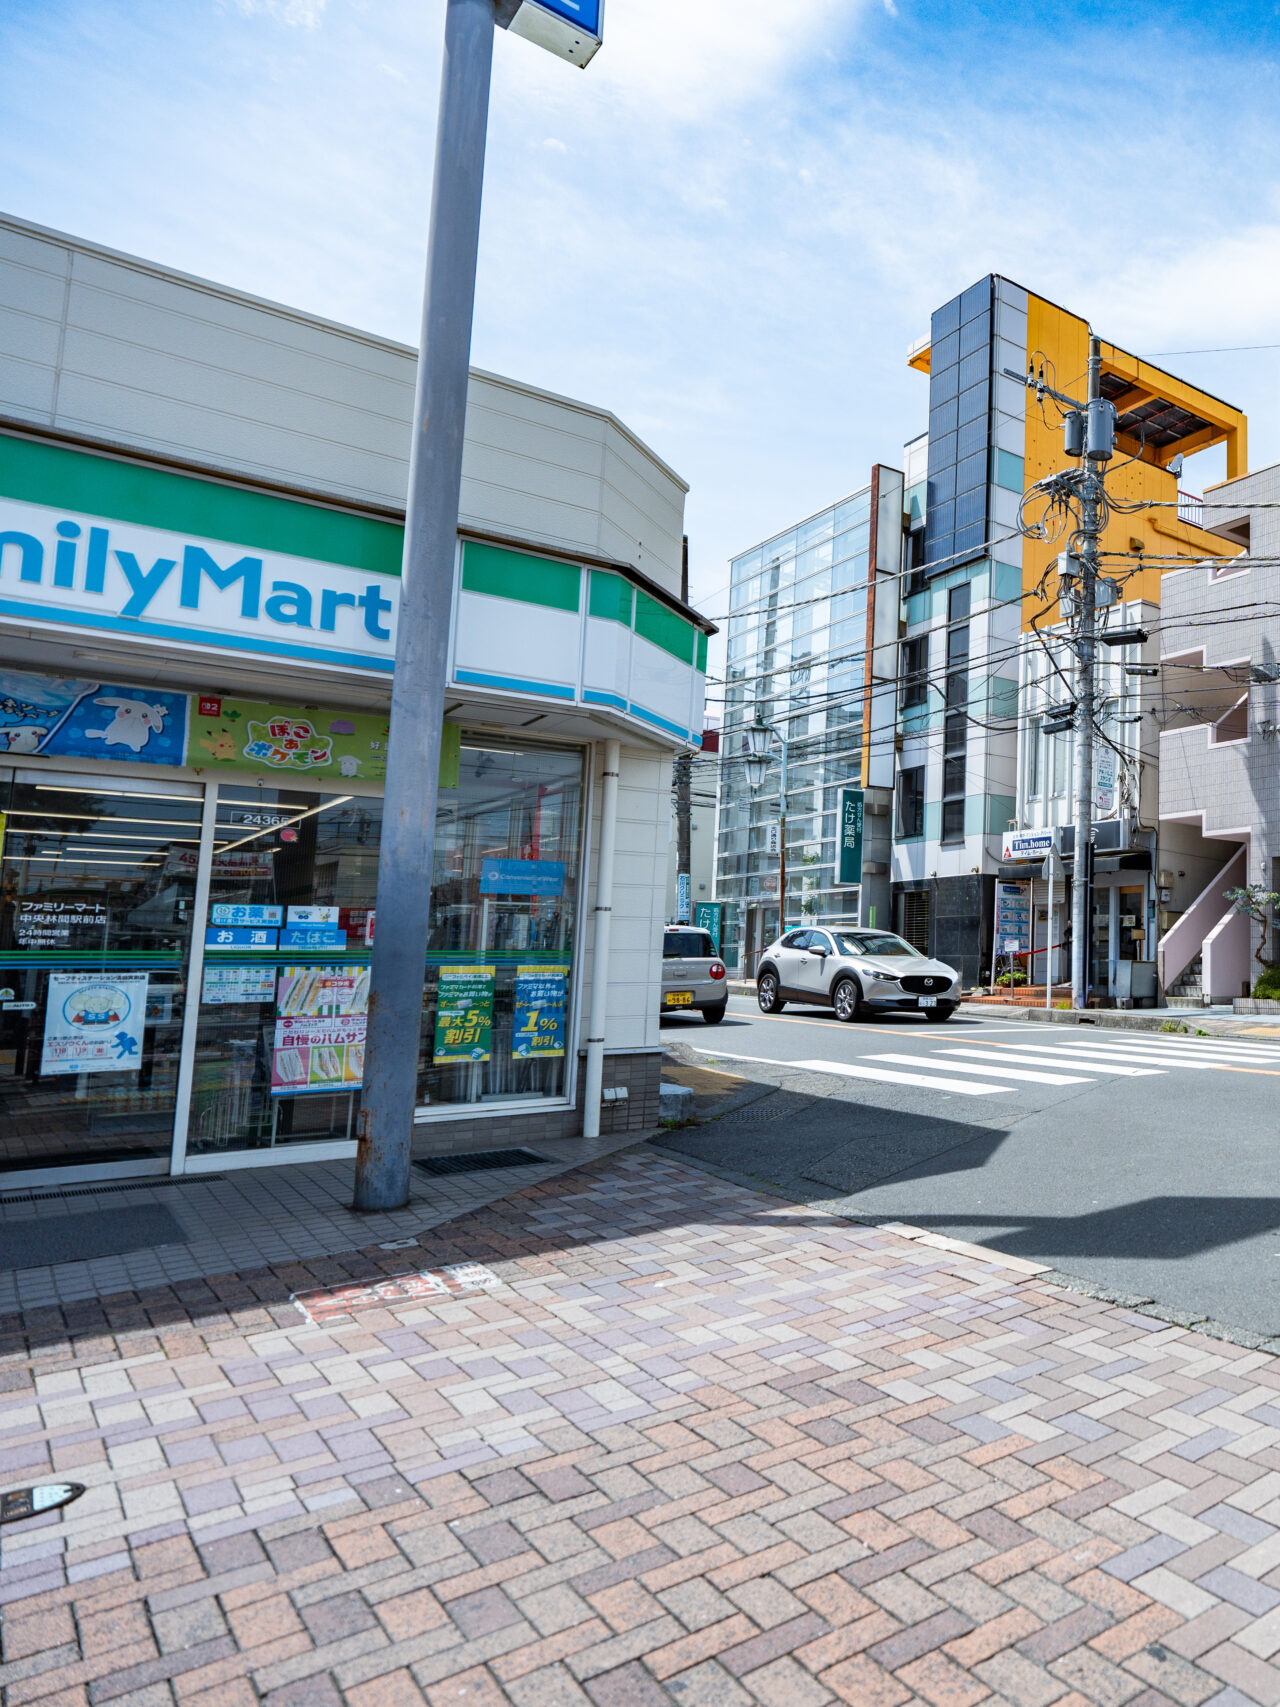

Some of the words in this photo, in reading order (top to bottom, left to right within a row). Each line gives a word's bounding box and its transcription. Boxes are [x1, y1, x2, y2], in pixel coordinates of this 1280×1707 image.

[247, 740, 328, 765] ポケモン
[843, 800, 856, 849] たけ薬局
[1014, 839, 1050, 850] Tim.home
[21, 901, 106, 912] ファミリーマート
[231, 905, 265, 919] お薬
[19, 914, 107, 925] 中央林間駅前店
[18, 928, 70, 937] 24時間営業
[290, 930, 337, 944] たばこ
[444, 1028, 481, 1044] 割引
[531, 1035, 555, 1047] 割引
